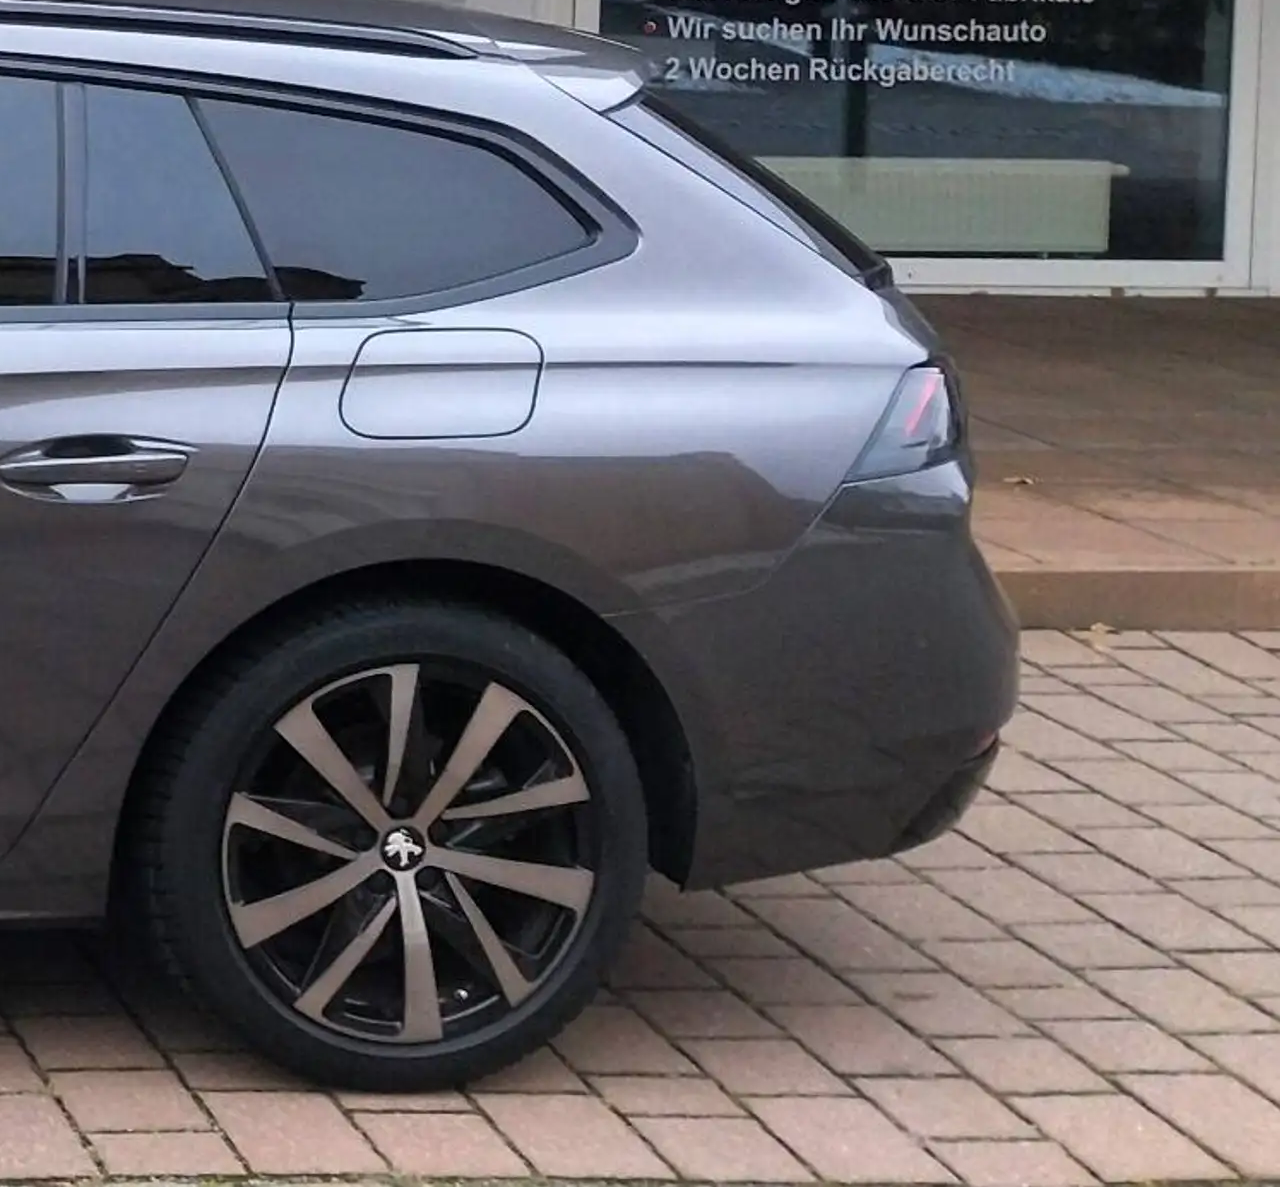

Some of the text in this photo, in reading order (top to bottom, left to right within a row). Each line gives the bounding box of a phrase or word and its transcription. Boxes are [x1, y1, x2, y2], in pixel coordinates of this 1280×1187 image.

[667, 16, 1047, 43] Wir suchen Ihr Wunschauto
[664, 57, 1017, 88] 2 Wochen Rückgaberecht
